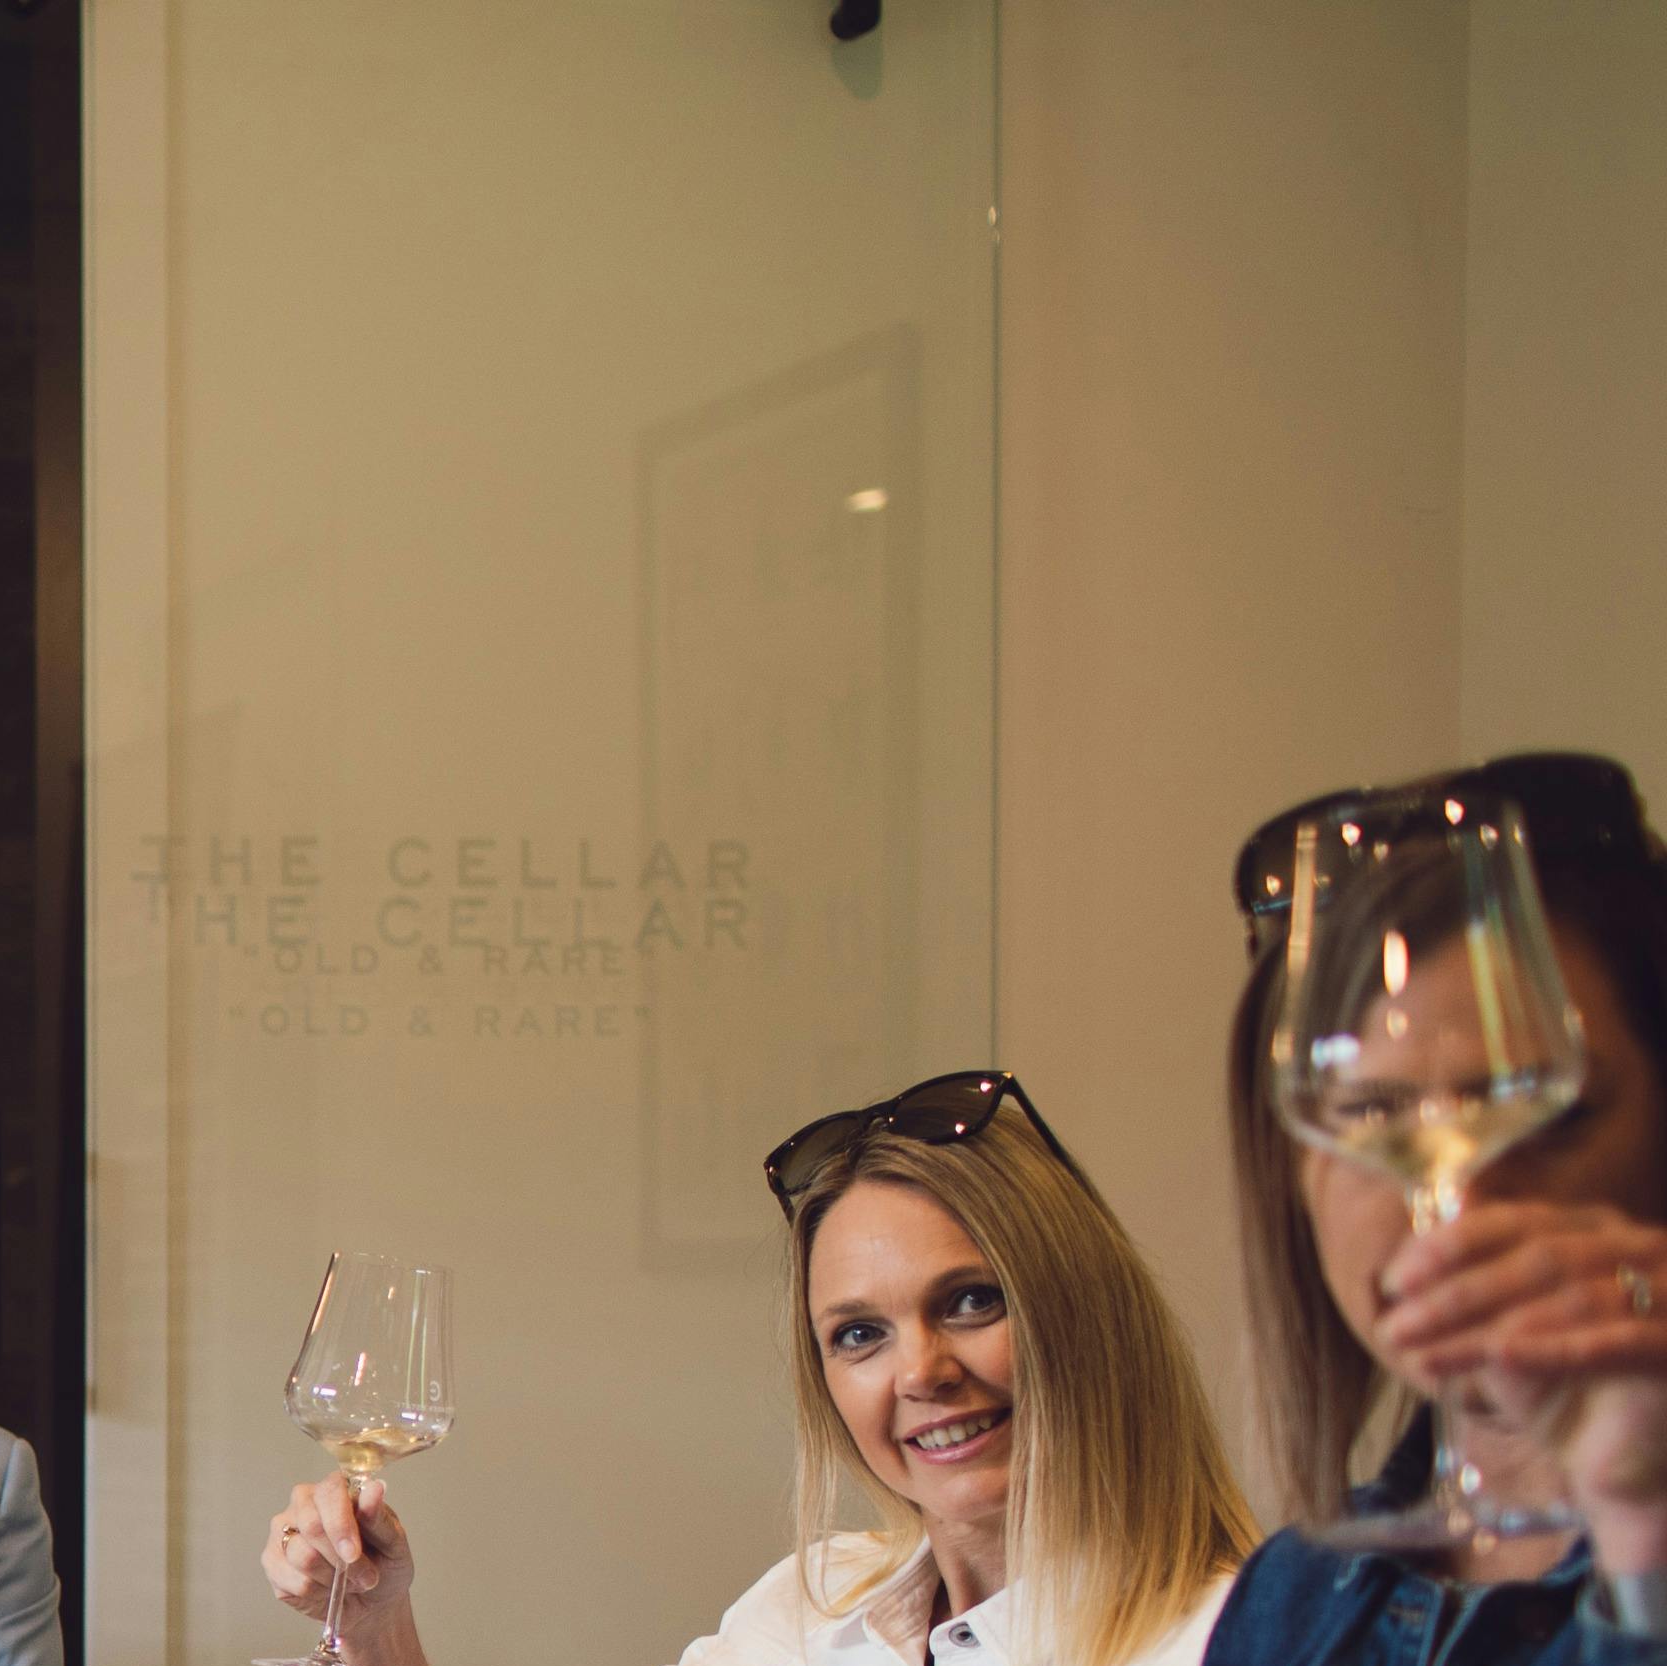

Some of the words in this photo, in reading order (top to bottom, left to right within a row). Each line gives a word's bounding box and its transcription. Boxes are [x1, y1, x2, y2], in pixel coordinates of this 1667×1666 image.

[140, 834, 322, 887] THE
[385, 835, 752, 891] CELLAR
[129, 871, 311, 948] THE
[375, 894, 749, 950] CELLAR
[407, 1005, 436, 1038] &
